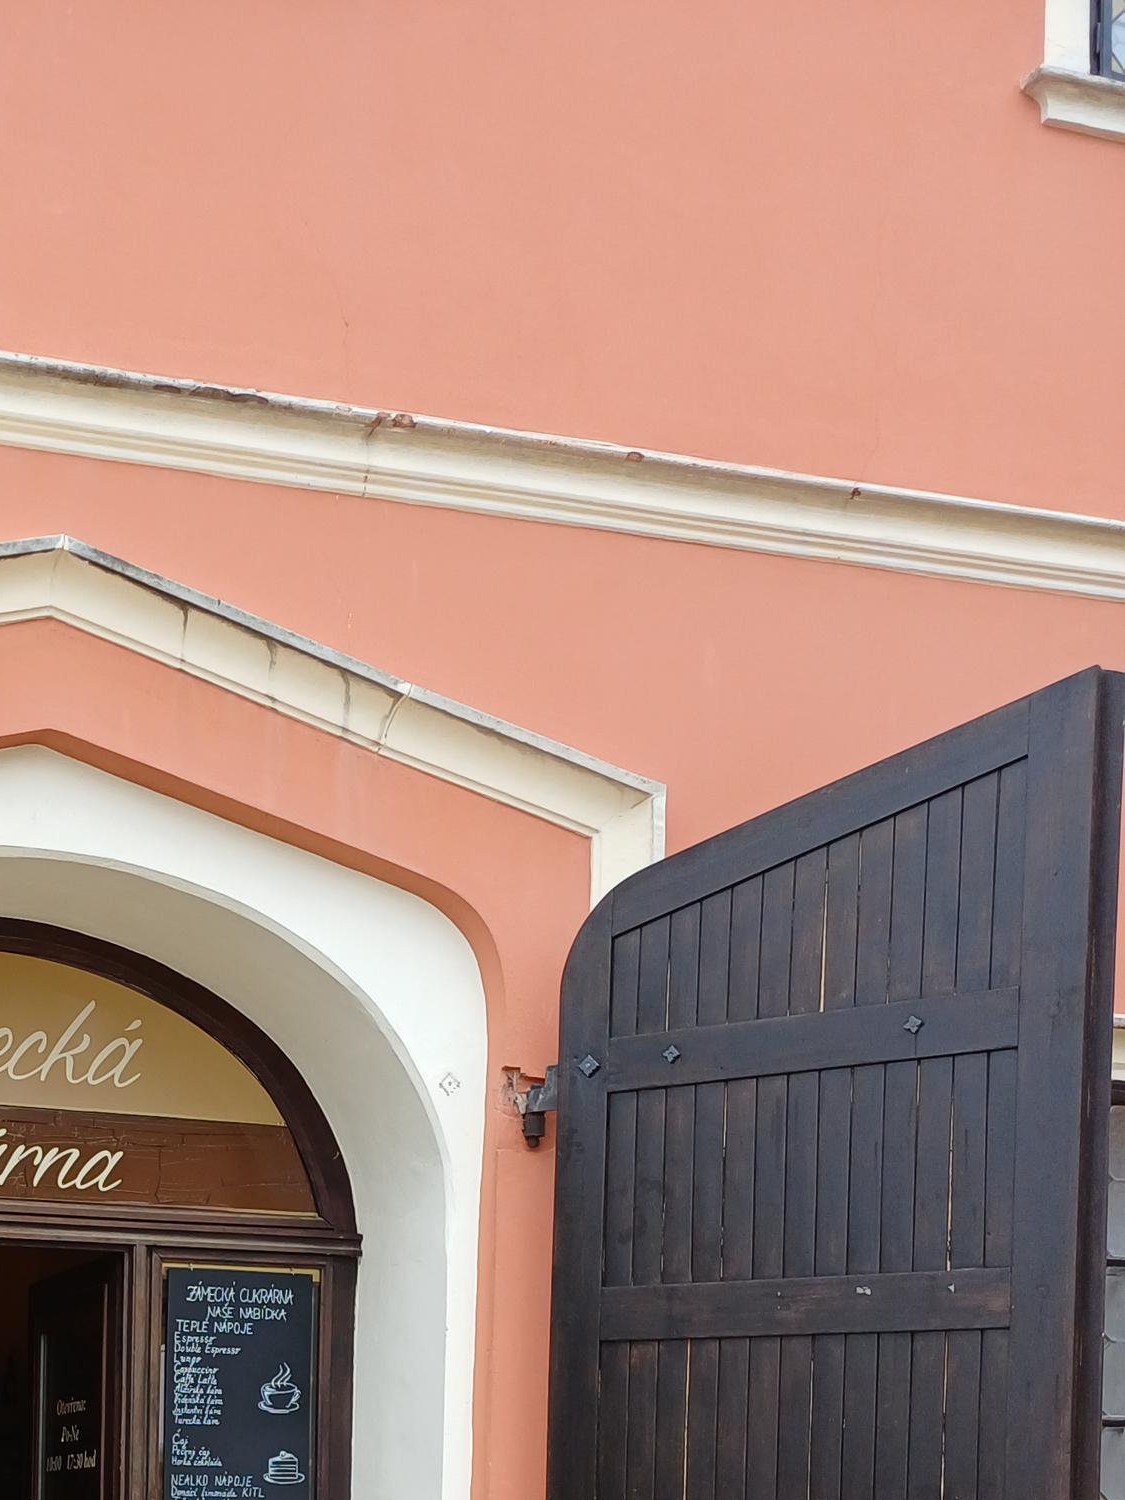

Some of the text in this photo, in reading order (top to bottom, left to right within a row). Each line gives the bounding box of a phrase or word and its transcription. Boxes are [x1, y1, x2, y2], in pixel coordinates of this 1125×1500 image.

[186, 1281, 294, 1305] ZÁMECKÁ CUKRÁRNA
[206, 1304, 287, 1322] NAŠE NABÍDKA
[175, 1319, 254, 1335] TEPLÉ NÁPOJE
[174, 1332, 217, 1347] Espresso
[174, 1343, 241, 1357] Double Espresso
[170, 1471, 253, 1487] NEALKO NÁPOJE
[241, 1486, 265, 1498] KITL
